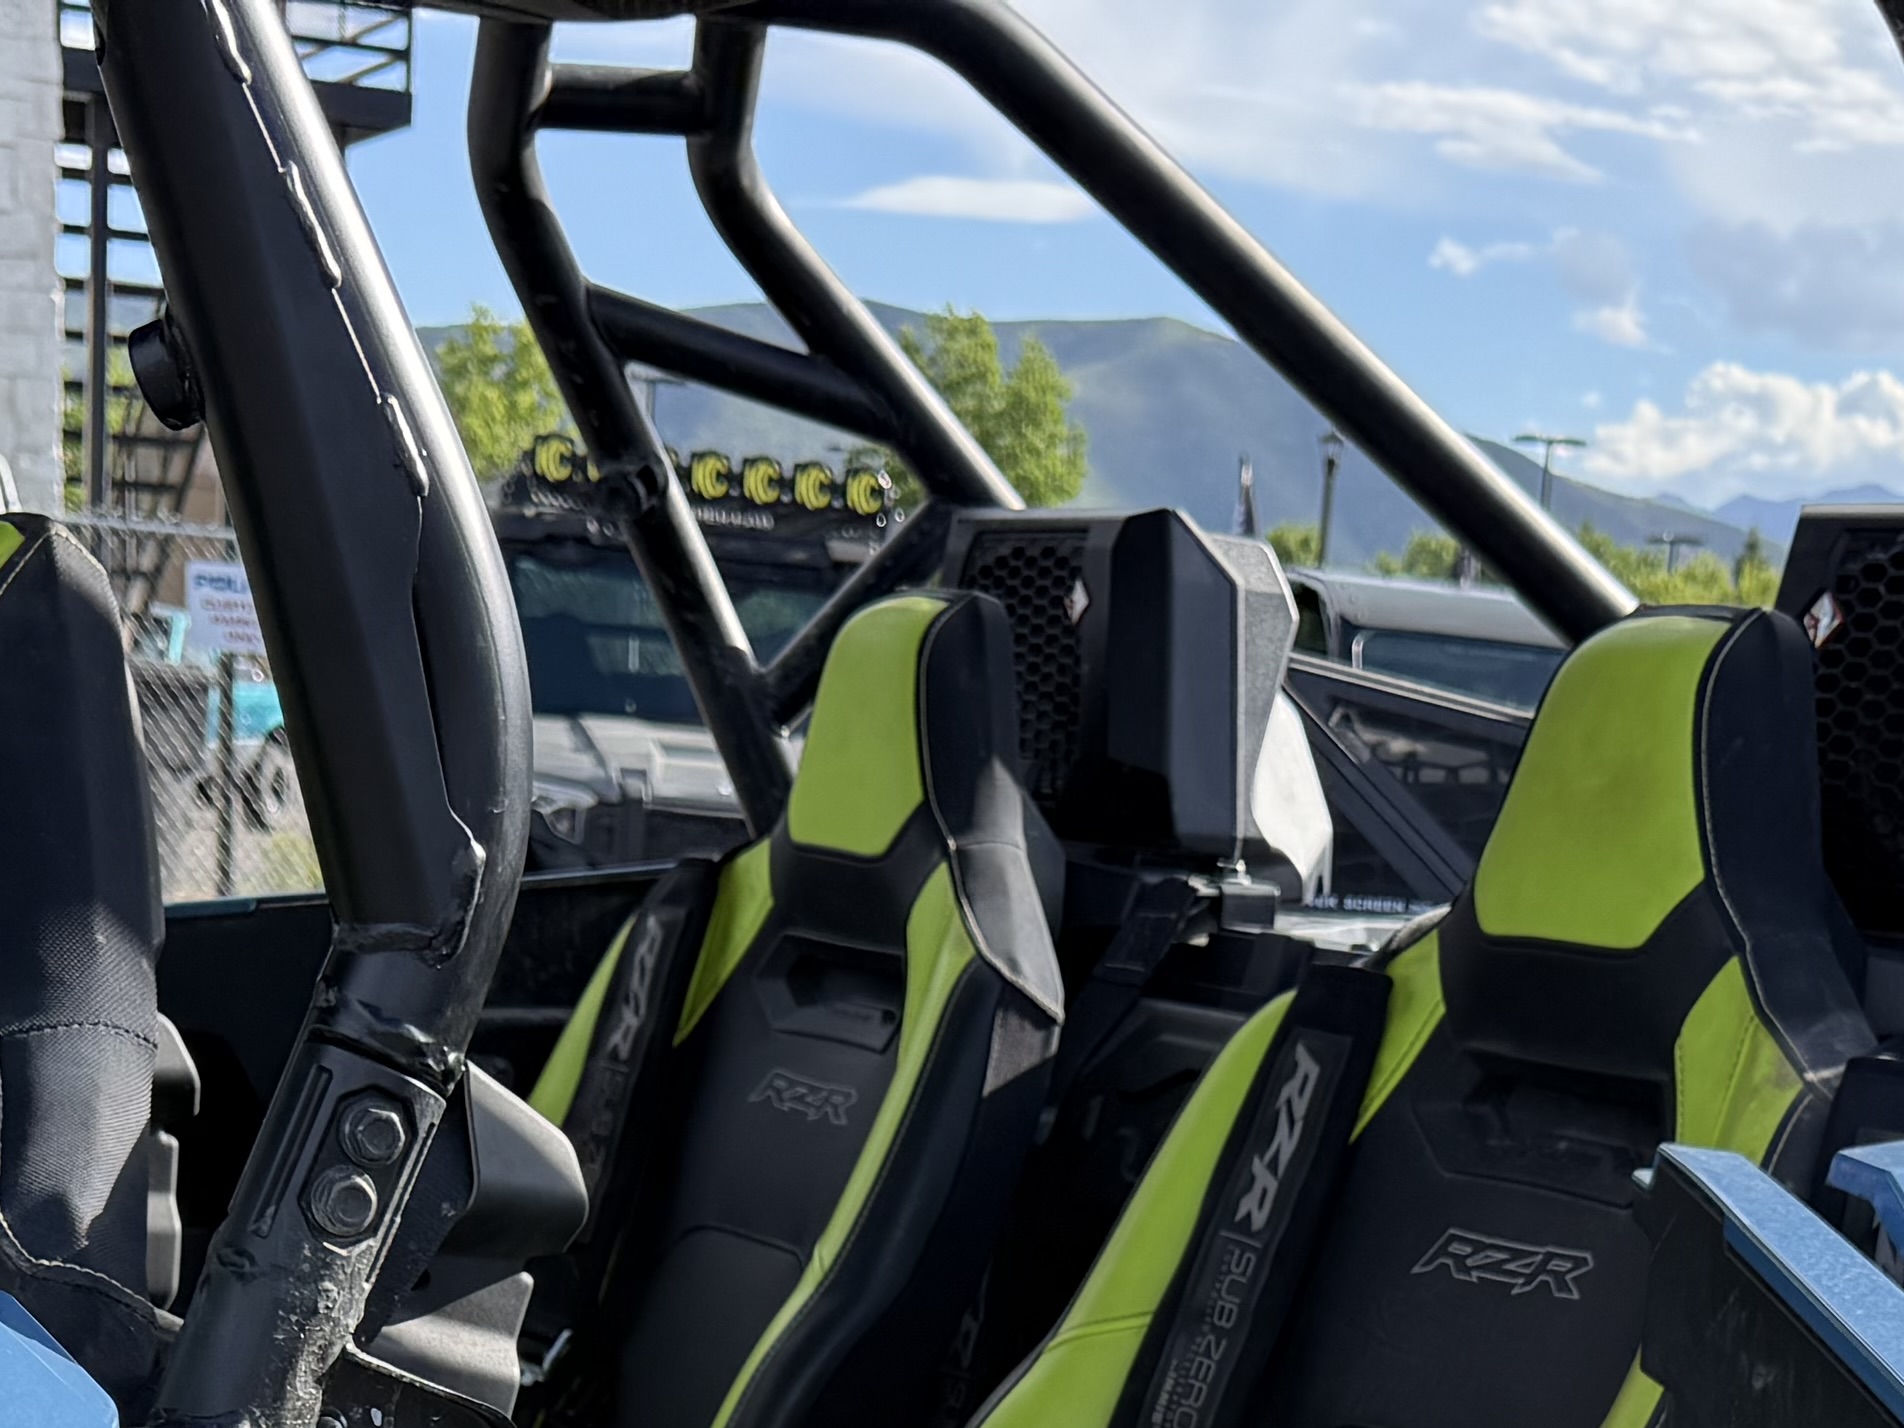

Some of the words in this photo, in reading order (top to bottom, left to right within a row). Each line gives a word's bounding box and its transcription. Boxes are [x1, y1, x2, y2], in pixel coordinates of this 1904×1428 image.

[747, 1071, 859, 1126] RZR
[1235, 1042, 1321, 1232] RZR
[1213, 1248, 1257, 1330] SUB
[1412, 1227, 1595, 1300] RZR
